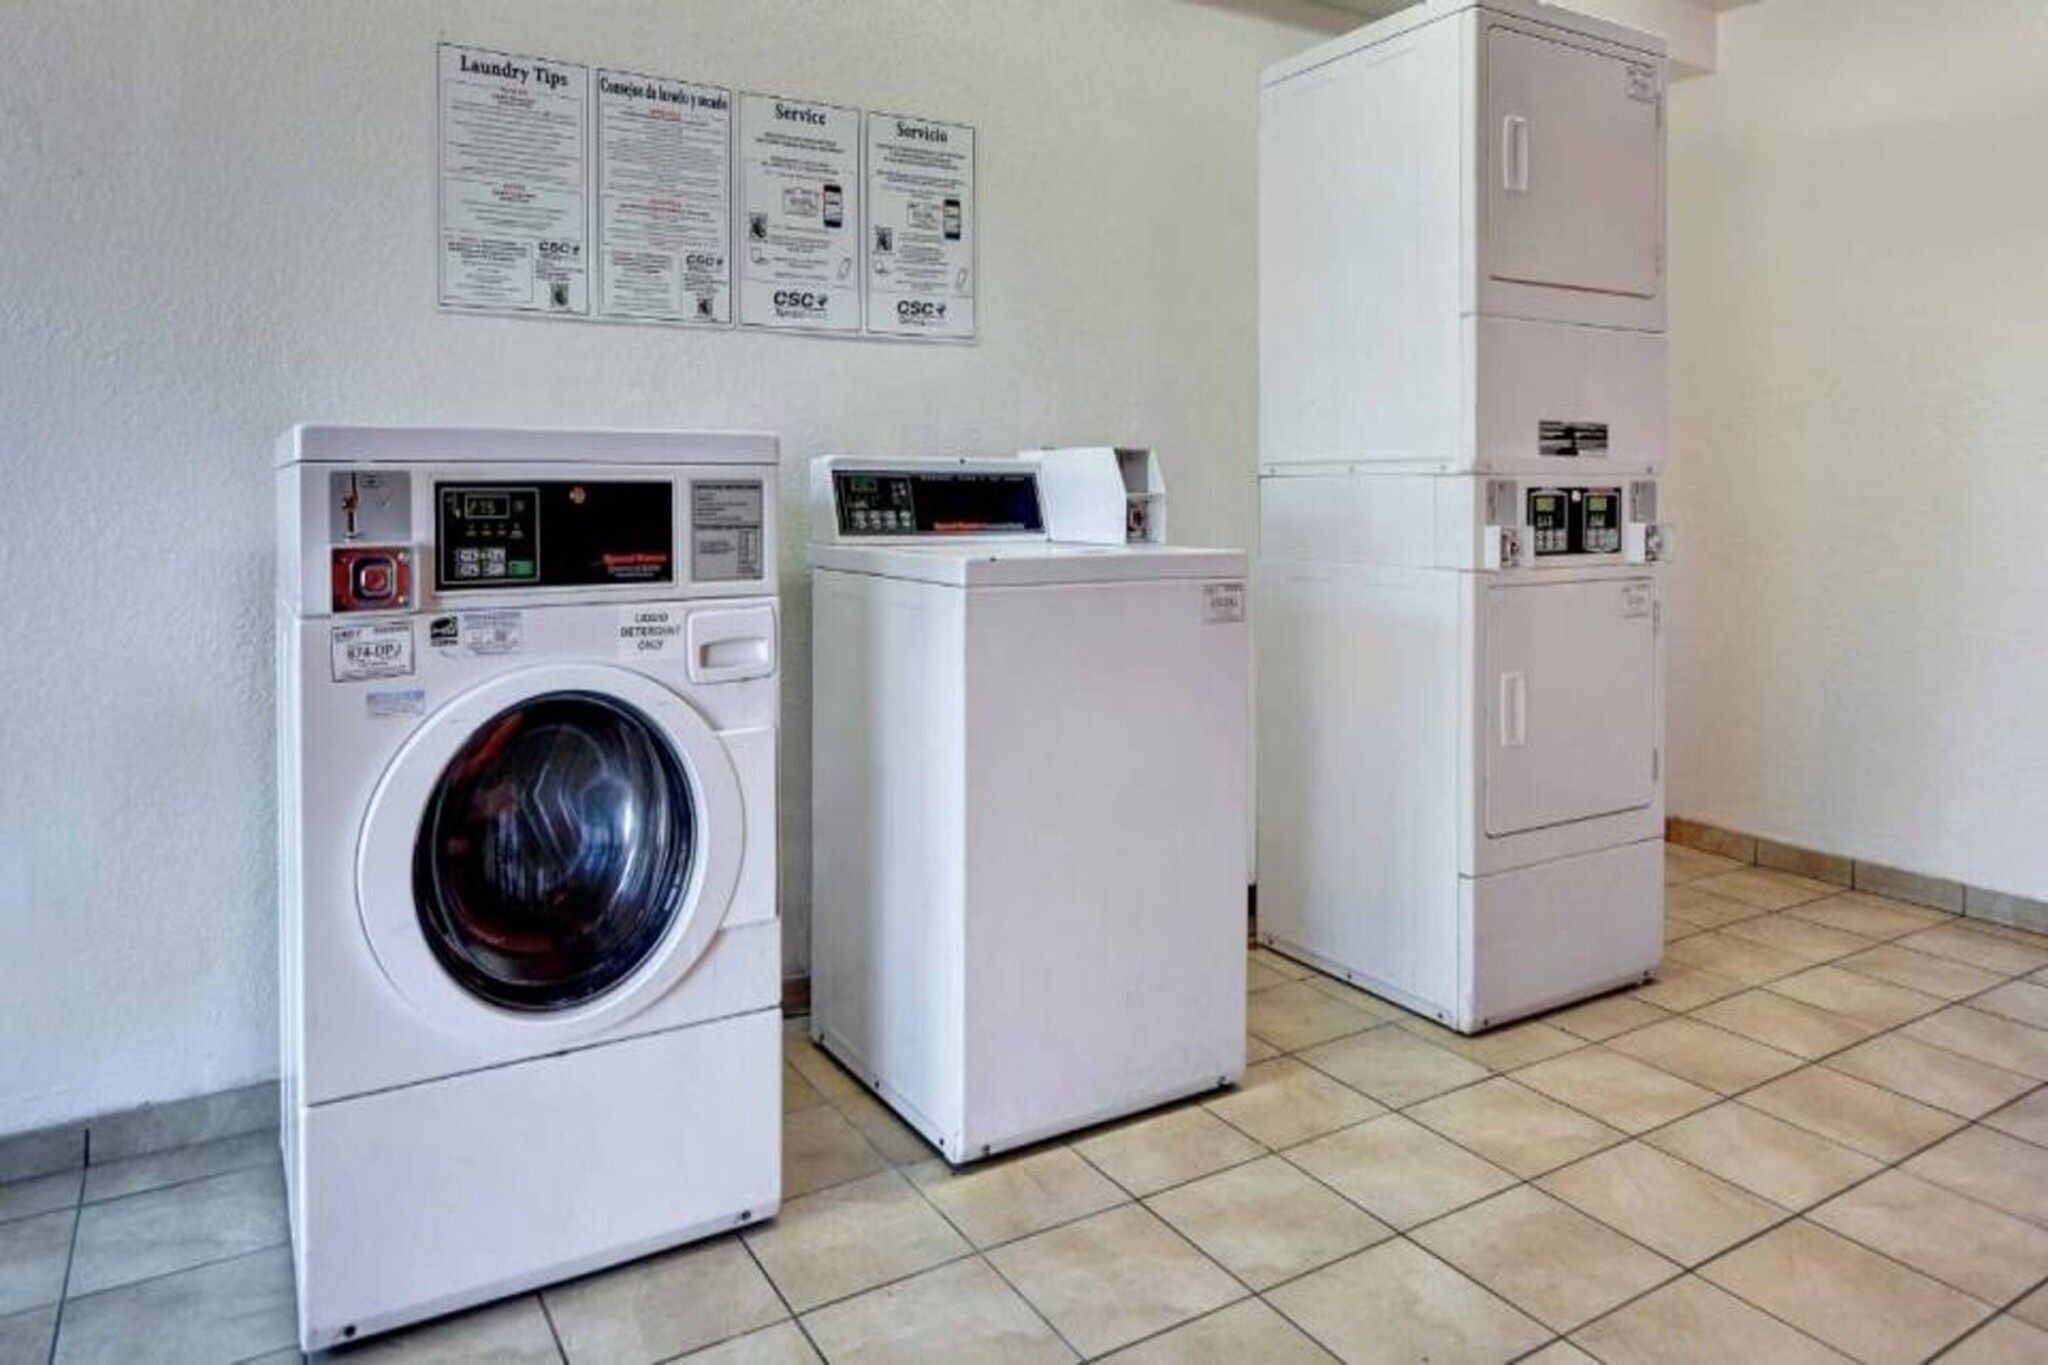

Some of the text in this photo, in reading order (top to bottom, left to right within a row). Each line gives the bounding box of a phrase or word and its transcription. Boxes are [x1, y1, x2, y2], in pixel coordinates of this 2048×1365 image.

[460, 54, 569, 90] Laundry Tips
[775, 103, 826, 127] Service
[896, 121, 948, 143] Servicio
[773, 290, 815, 308] CSC
[897, 300, 934, 316] CSC
